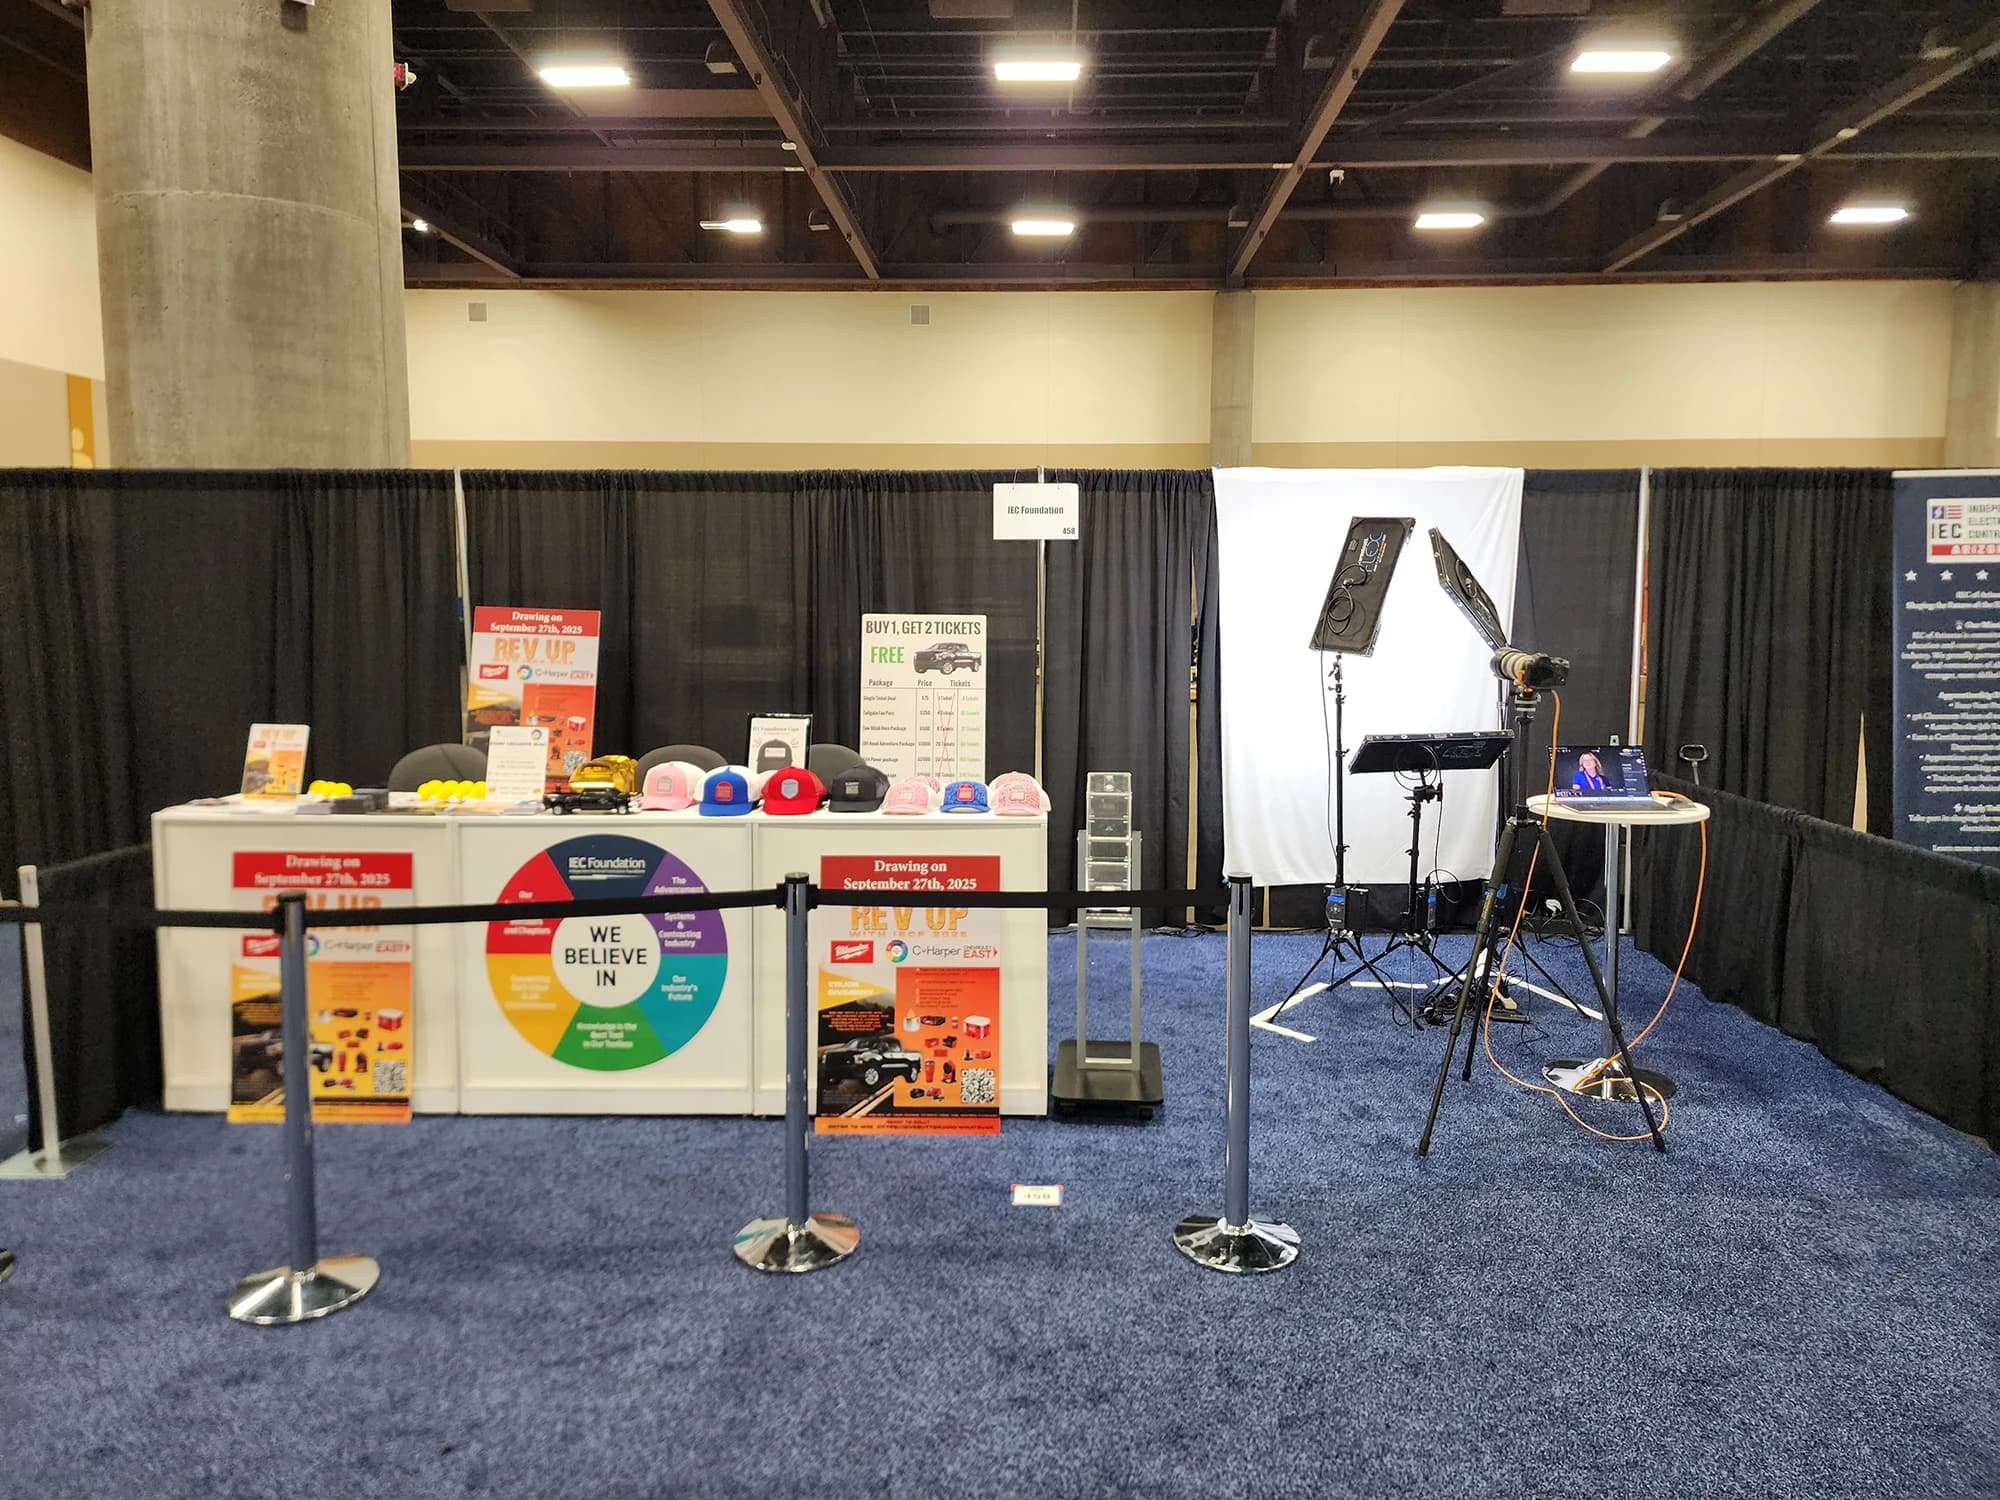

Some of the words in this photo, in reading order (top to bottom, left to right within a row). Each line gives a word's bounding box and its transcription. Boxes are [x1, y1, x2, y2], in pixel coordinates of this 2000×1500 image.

[1007, 506, 1020, 514] IEC
[1021, 506, 1064, 515] Foundation
[1931, 523, 1961, 539] IEC
[512, 611, 549, 624] Drawing
[490, 622, 536, 632] September
[538, 624, 560, 634] 27th,
[562, 625, 583, 634] 2025
[866, 621, 890, 634] BUY
[902, 621, 924, 635] GET
[925, 621, 933, 635] 2
[935, 621, 981, 635] TICKETS
[494, 637, 539, 661] REV
[546, 640, 576, 663] UP
[871, 646, 905, 663] FREE
[869, 679, 893, 687] Package
[917, 679, 933, 687] Price
[286, 855, 342, 871] Drawing
[343, 858, 361, 868] on
[568, 857, 586, 868] IEC
[588, 857, 646, 869] Foundation
[874, 860, 929, 875] Drawing
[931, 863, 947, 872] on
[254, 872, 322, 887] September
[360, 873, 391, 886] 2025
[672, 876, 686, 885] The
[843, 877, 910, 890] September
[913, 878, 944, 890] 27th,
[948, 878, 977, 890] 2025
[590, 927, 621, 943] WE
[565, 948, 647, 965] BELIEVE
[963, 949, 991, 958] EAST
[596, 970, 616, 986] IN
